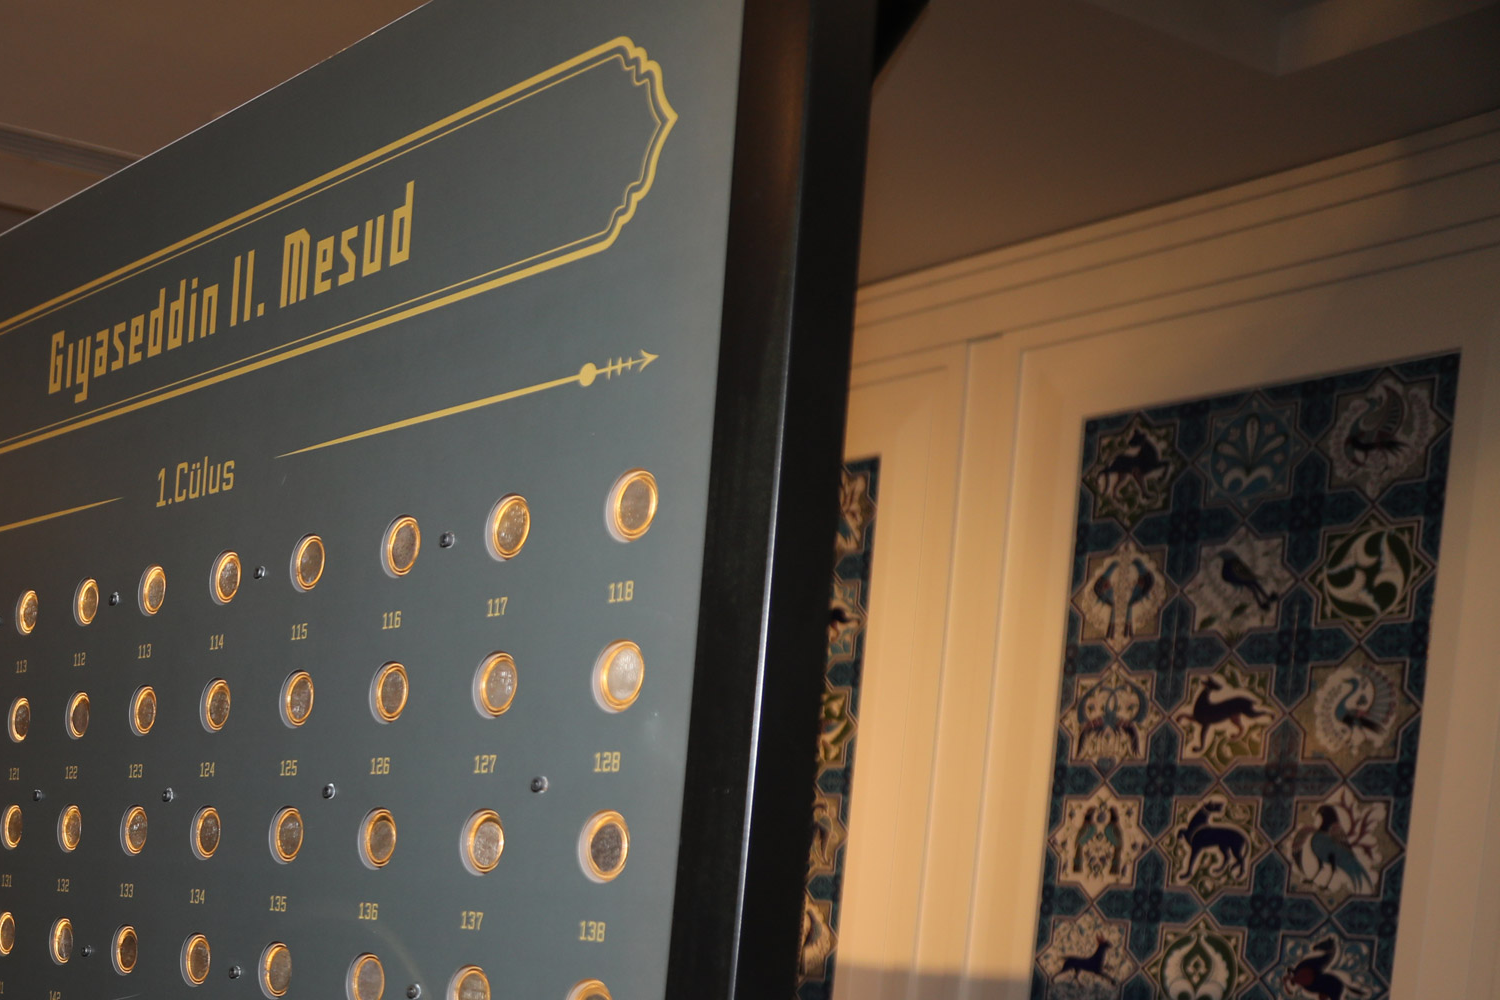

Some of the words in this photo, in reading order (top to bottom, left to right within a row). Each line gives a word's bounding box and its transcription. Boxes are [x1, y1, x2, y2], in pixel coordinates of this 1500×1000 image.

[230, 249, 265, 327] II.
[280, 179, 415, 309] Mesud
[156, 455, 235, 507] 1.Cülus
[607, 579, 636, 604] 118
[486, 595, 510, 618] 117
[381, 609, 403, 631] 116
[290, 621, 309, 641] 115
[136, 642, 154, 660] 113
[209, 634, 226, 651] 114
[15, 658, 29, 675] 113
[72, 650, 88, 668] 112
[127, 762, 145, 779] 123
[199, 761, 217, 779] 124
[279, 758, 299, 777] 125
[369, 755, 392, 776] 126
[473, 753, 498, 775] 127
[593, 750, 622, 774] 128
[7, 766, 21, 782] 121
[64, 764, 80, 780] 122
[0, 873, 13, 888] 131
[56, 877, 71, 894] 132
[118, 882, 135, 899] 133
[189, 887, 207, 905] 134
[269, 894, 288, 913] 135
[357, 901, 380, 921] 136
[459, 909, 485, 931] 137
[578, 919, 607, 943] 138
